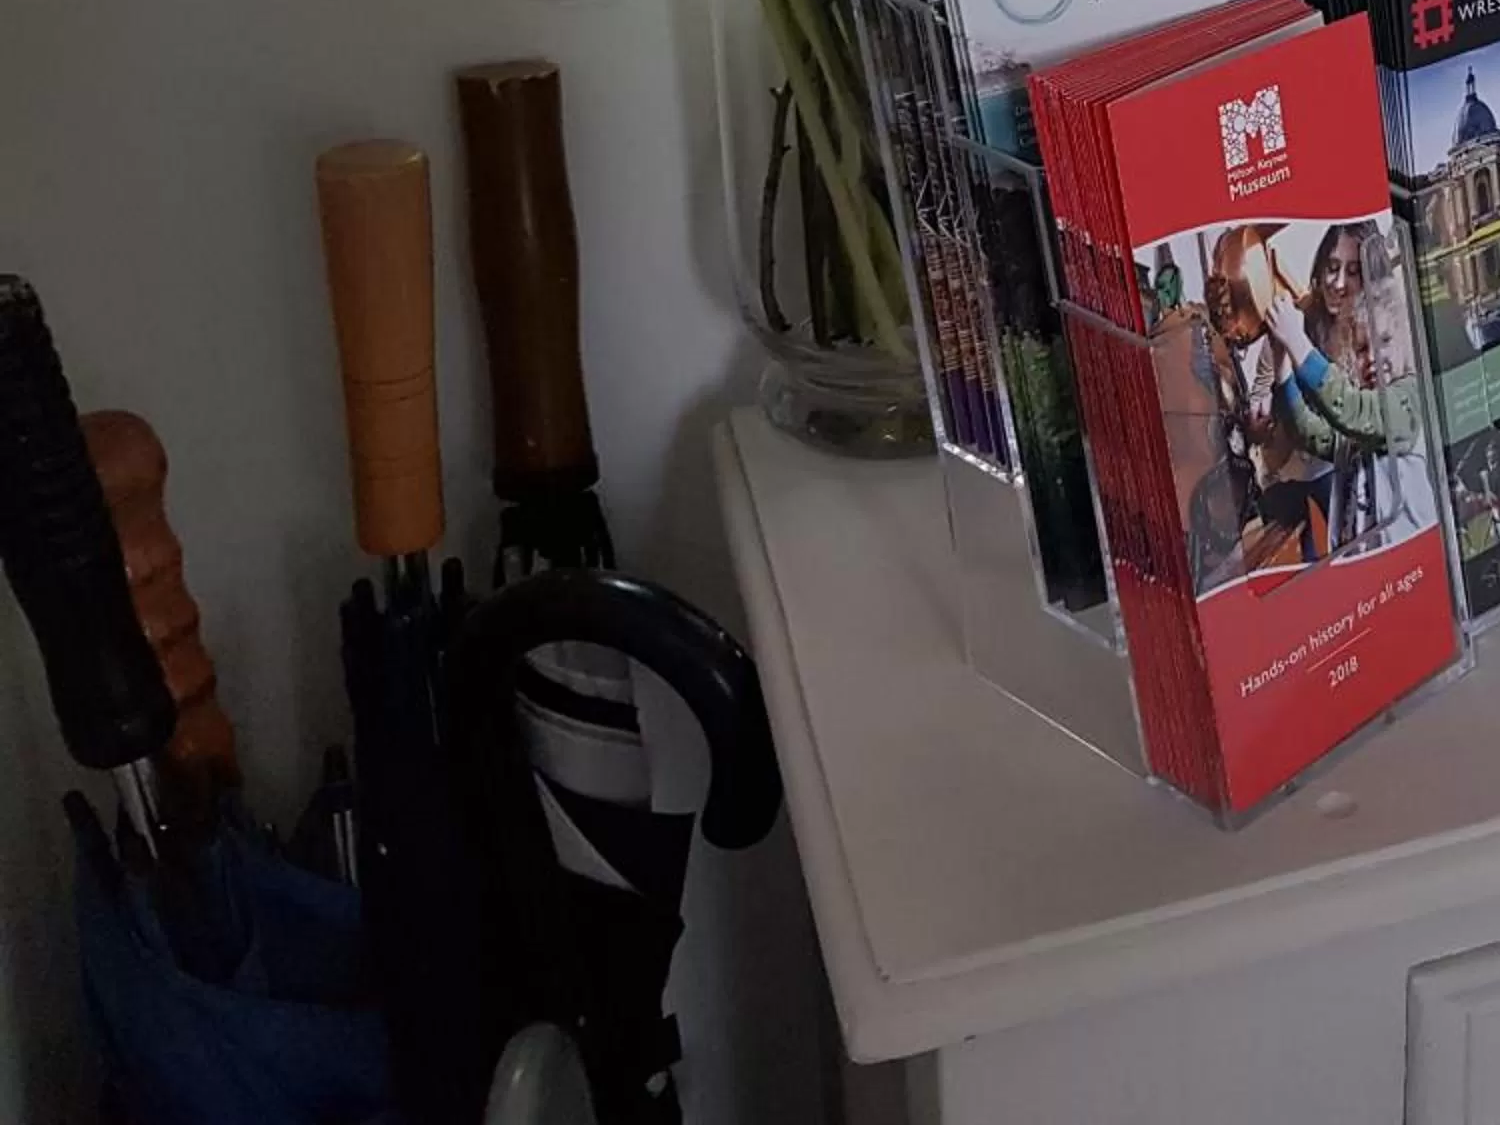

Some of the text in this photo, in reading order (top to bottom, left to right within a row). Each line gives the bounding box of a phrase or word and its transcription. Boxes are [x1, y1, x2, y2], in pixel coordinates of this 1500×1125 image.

[1229, 166, 1292, 202] Museum
[1239, 565, 1424, 698] Hands-on history for all ages
[1327, 655, 1360, 688] 2018
